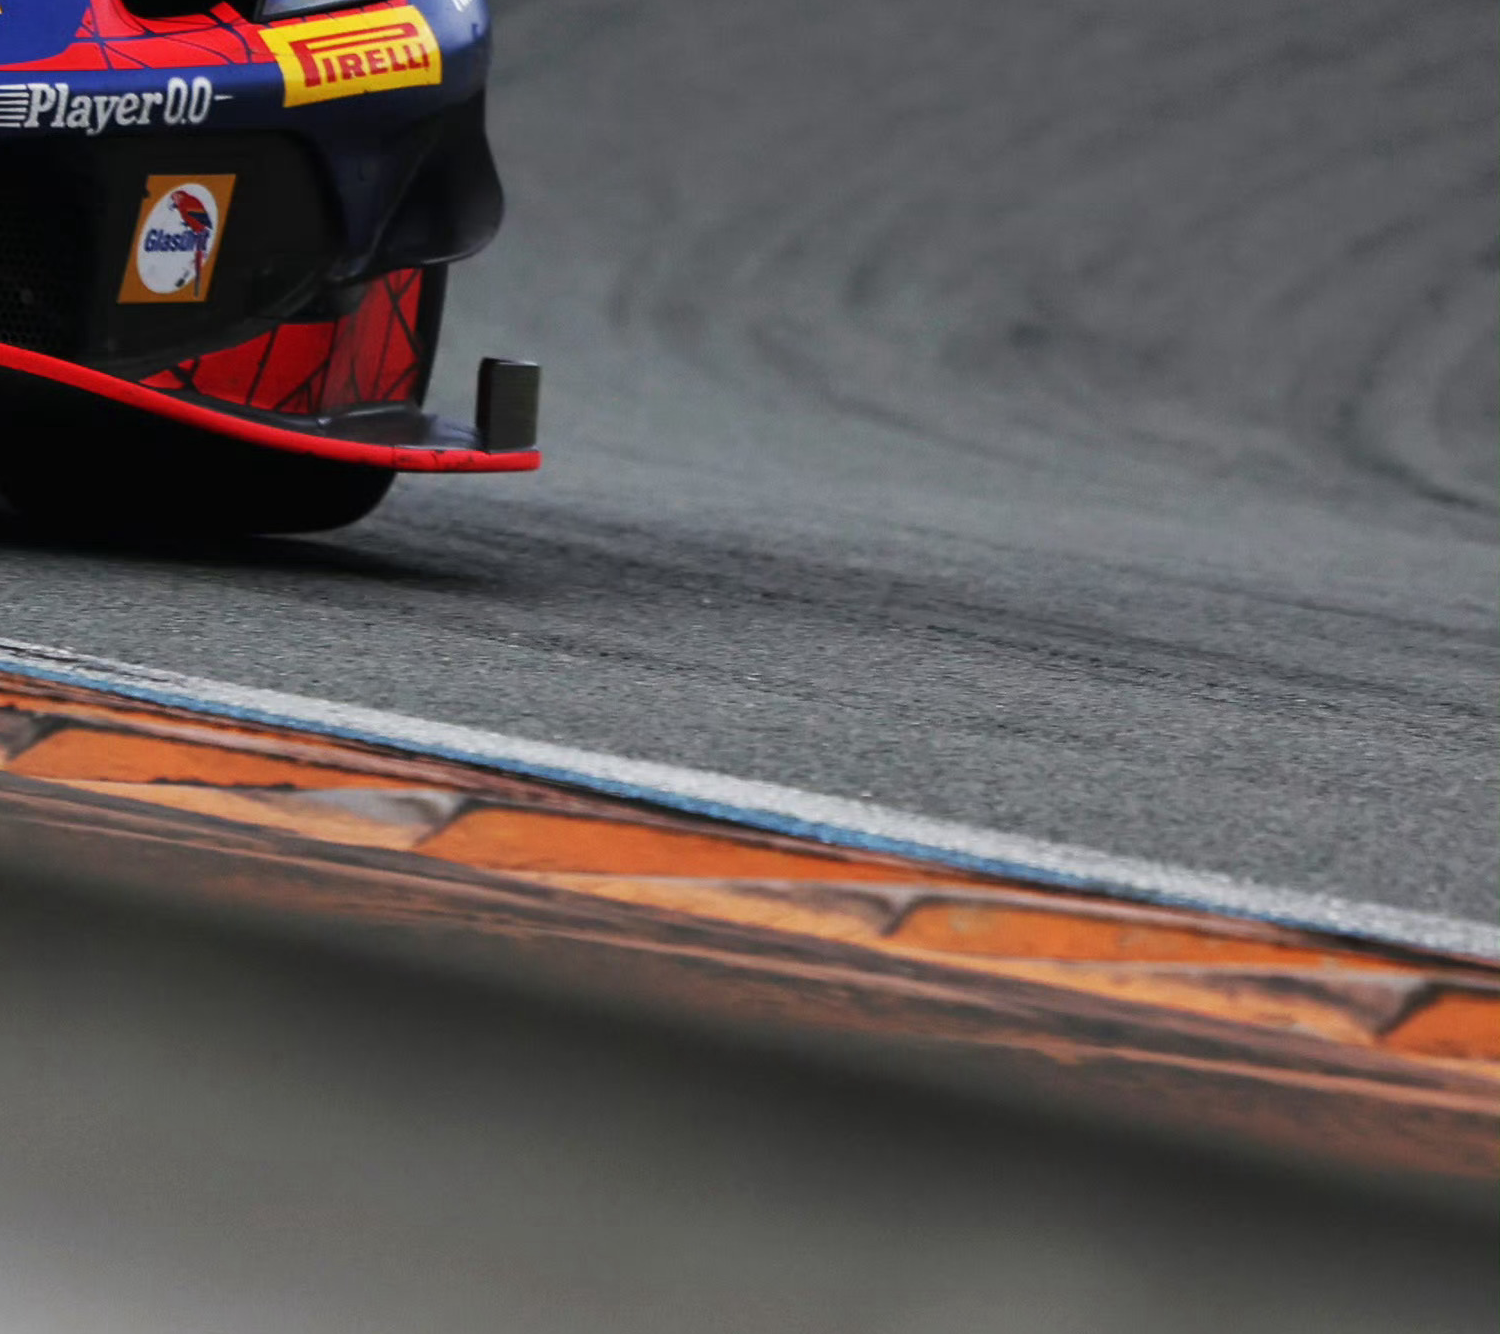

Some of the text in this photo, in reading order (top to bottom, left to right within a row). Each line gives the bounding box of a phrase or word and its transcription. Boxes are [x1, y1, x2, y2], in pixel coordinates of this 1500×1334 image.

[288, 22, 431, 87] PIRELLI
[23, 76, 213, 135] Player 0.0
